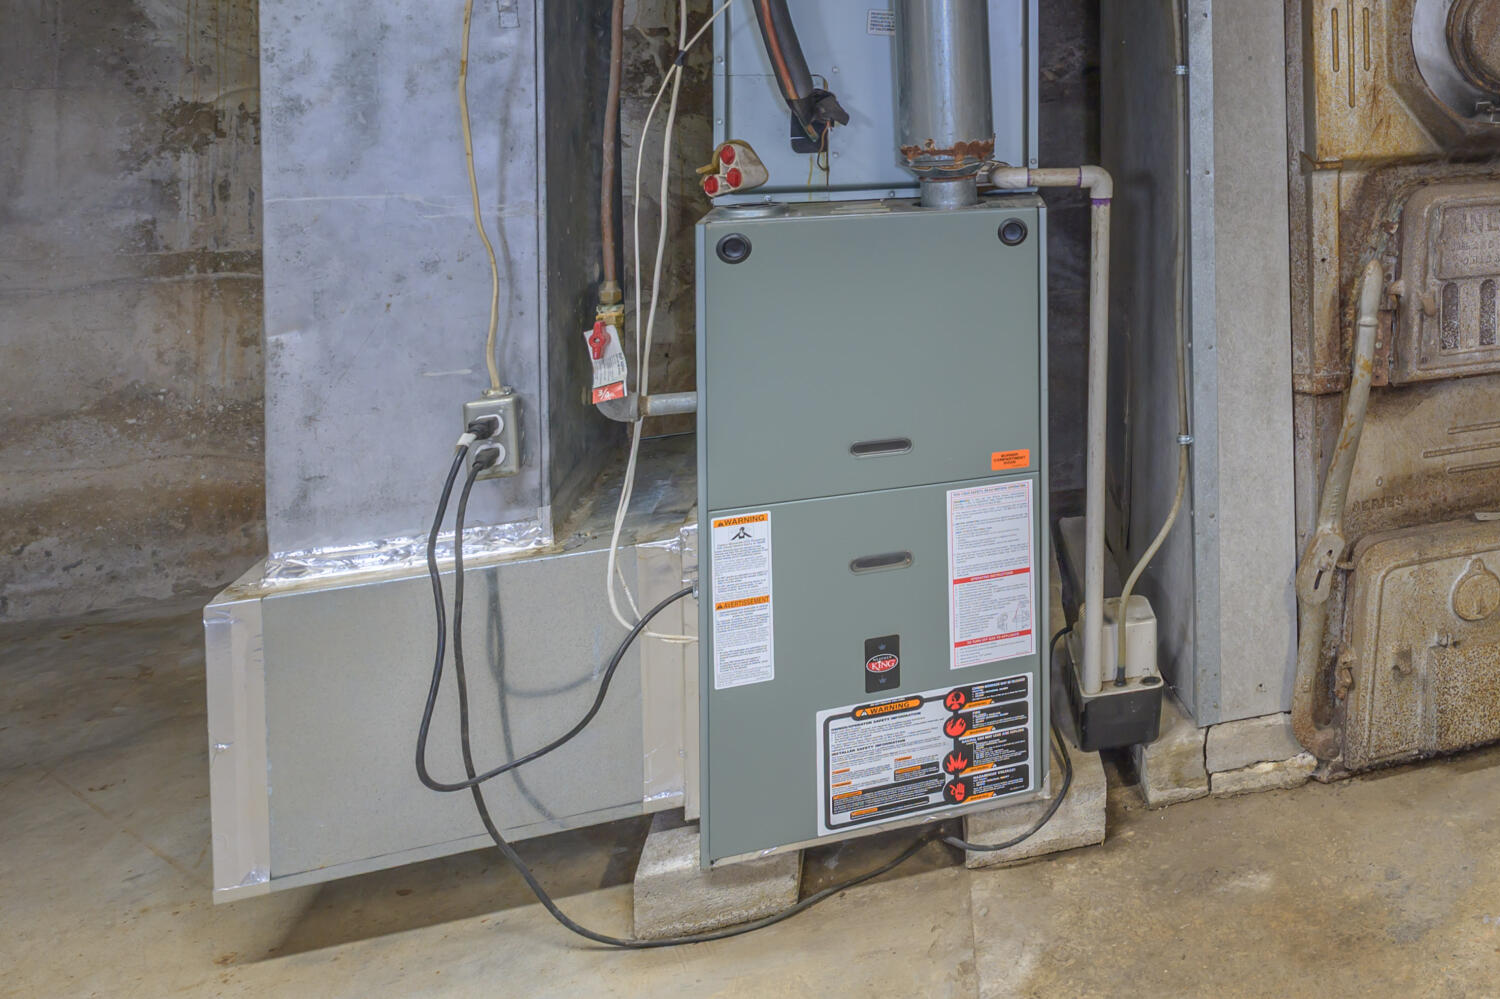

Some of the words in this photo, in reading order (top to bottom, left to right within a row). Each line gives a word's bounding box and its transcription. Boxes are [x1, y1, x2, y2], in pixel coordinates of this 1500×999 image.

[724, 514, 765, 526] WARNING
[724, 595, 770, 608] AVERTISSEMENT
[871, 660, 895, 671] KING
[869, 701, 910, 714] WARNING
